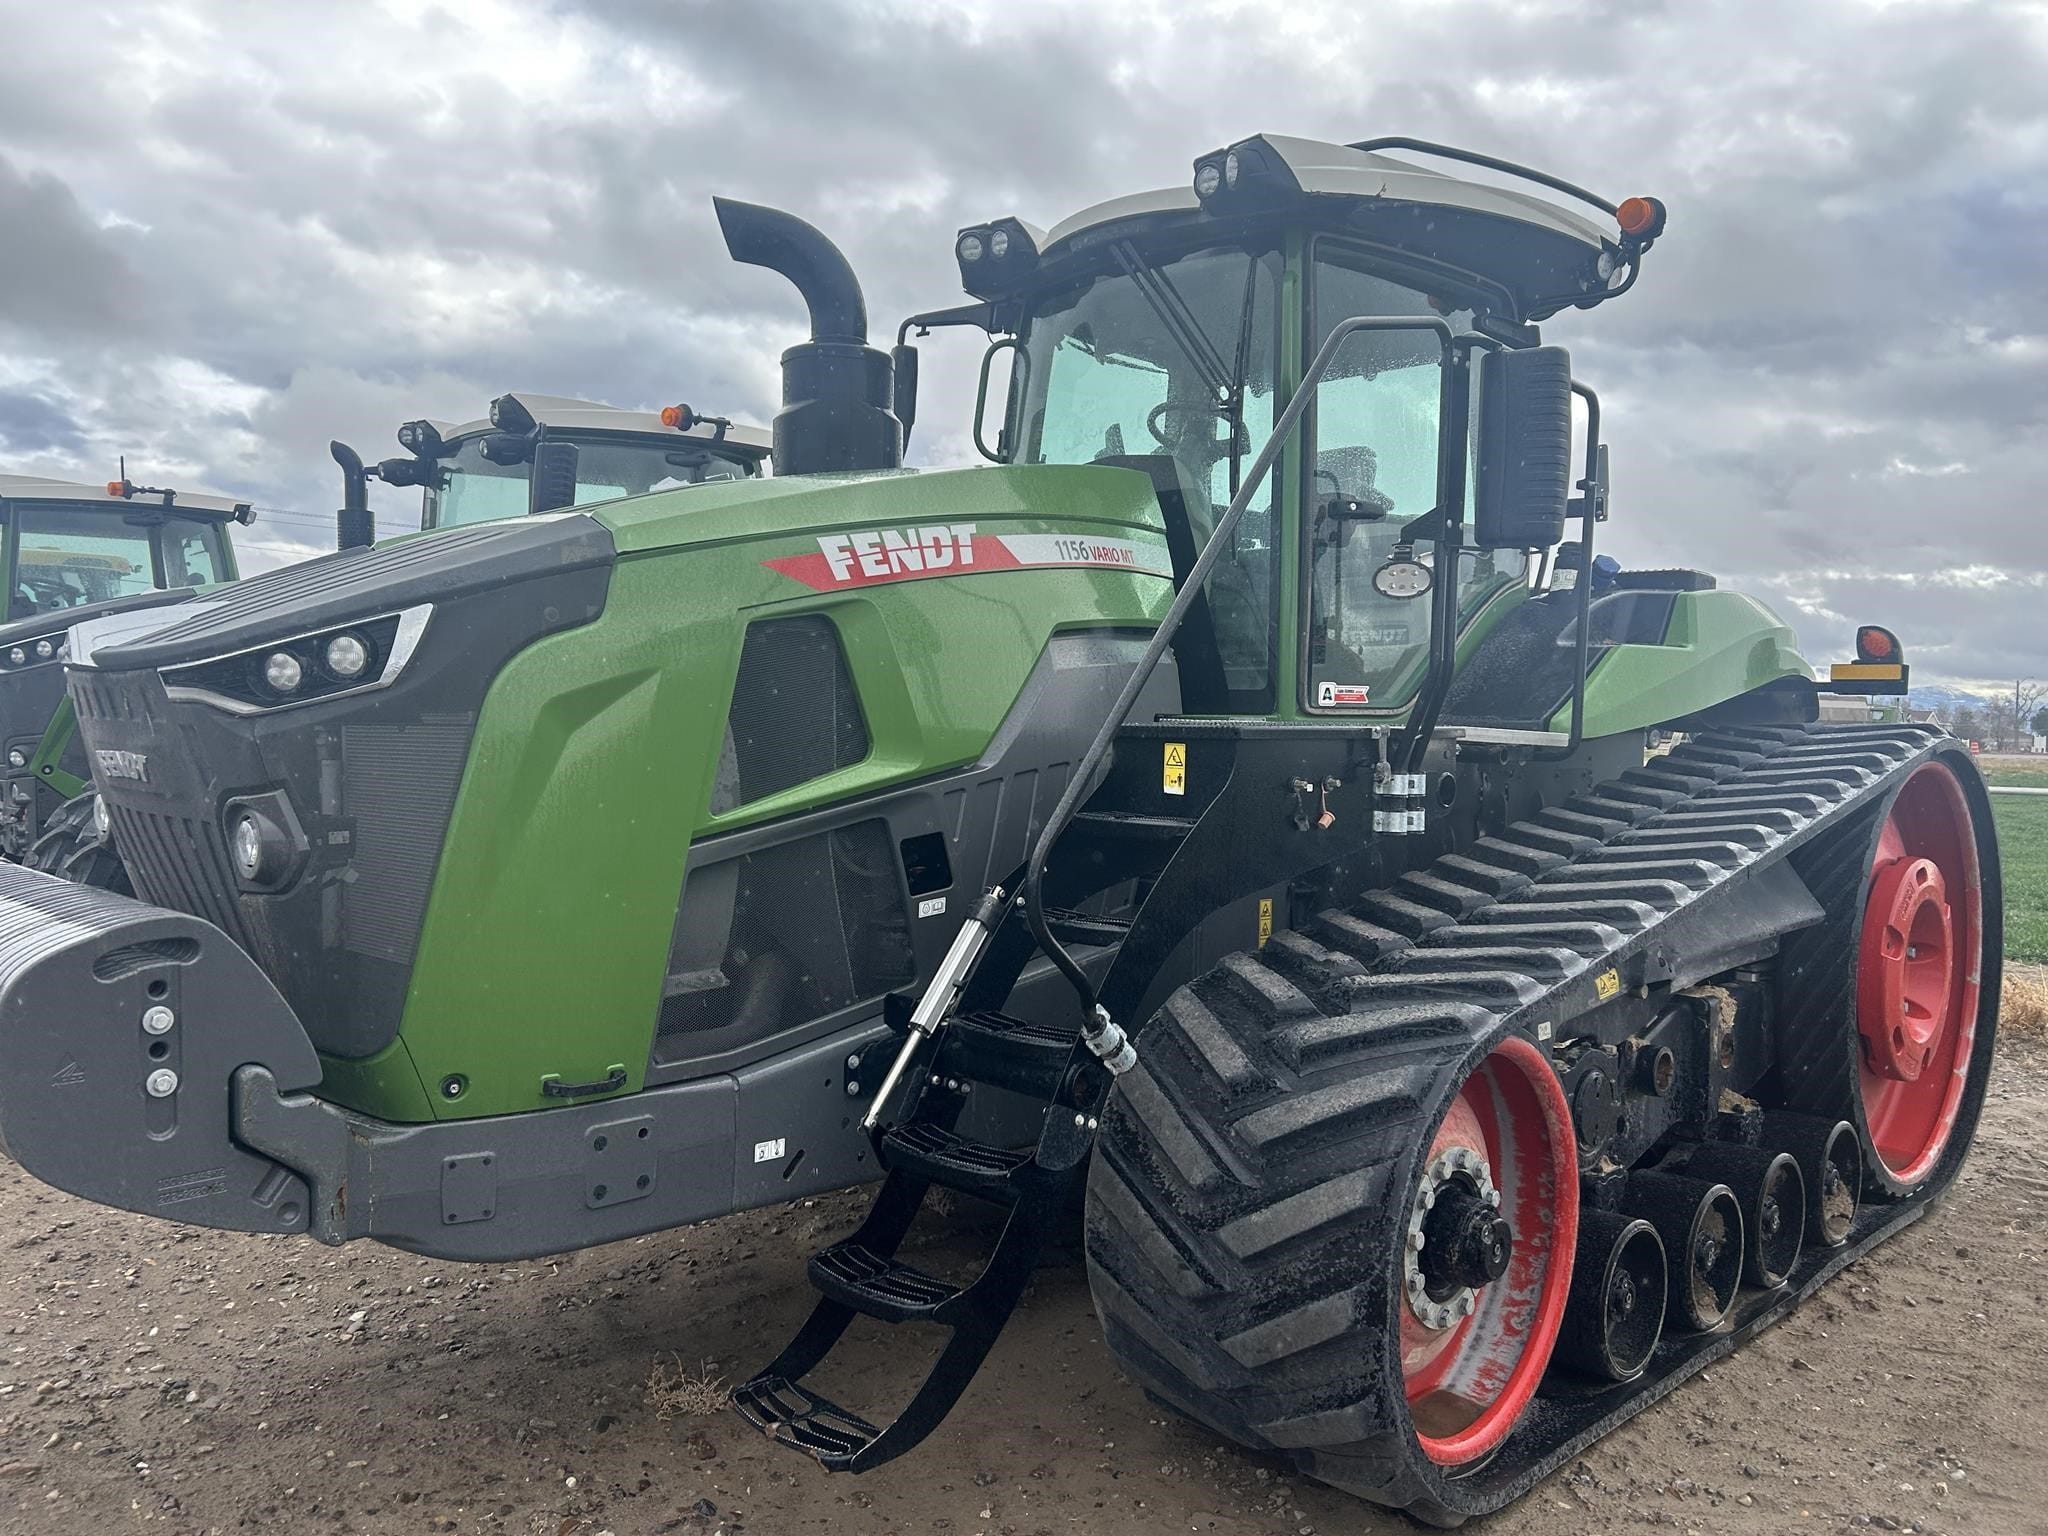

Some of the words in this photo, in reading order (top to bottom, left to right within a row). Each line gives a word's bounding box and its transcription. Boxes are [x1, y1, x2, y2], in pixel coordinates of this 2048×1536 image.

[816, 523, 977, 581] FENDT
[1055, 539, 1090, 561] 1156
[1088, 545, 1120, 563] VARIO
[1119, 548, 1135, 565] MT
[96, 749, 148, 782] FENDT
